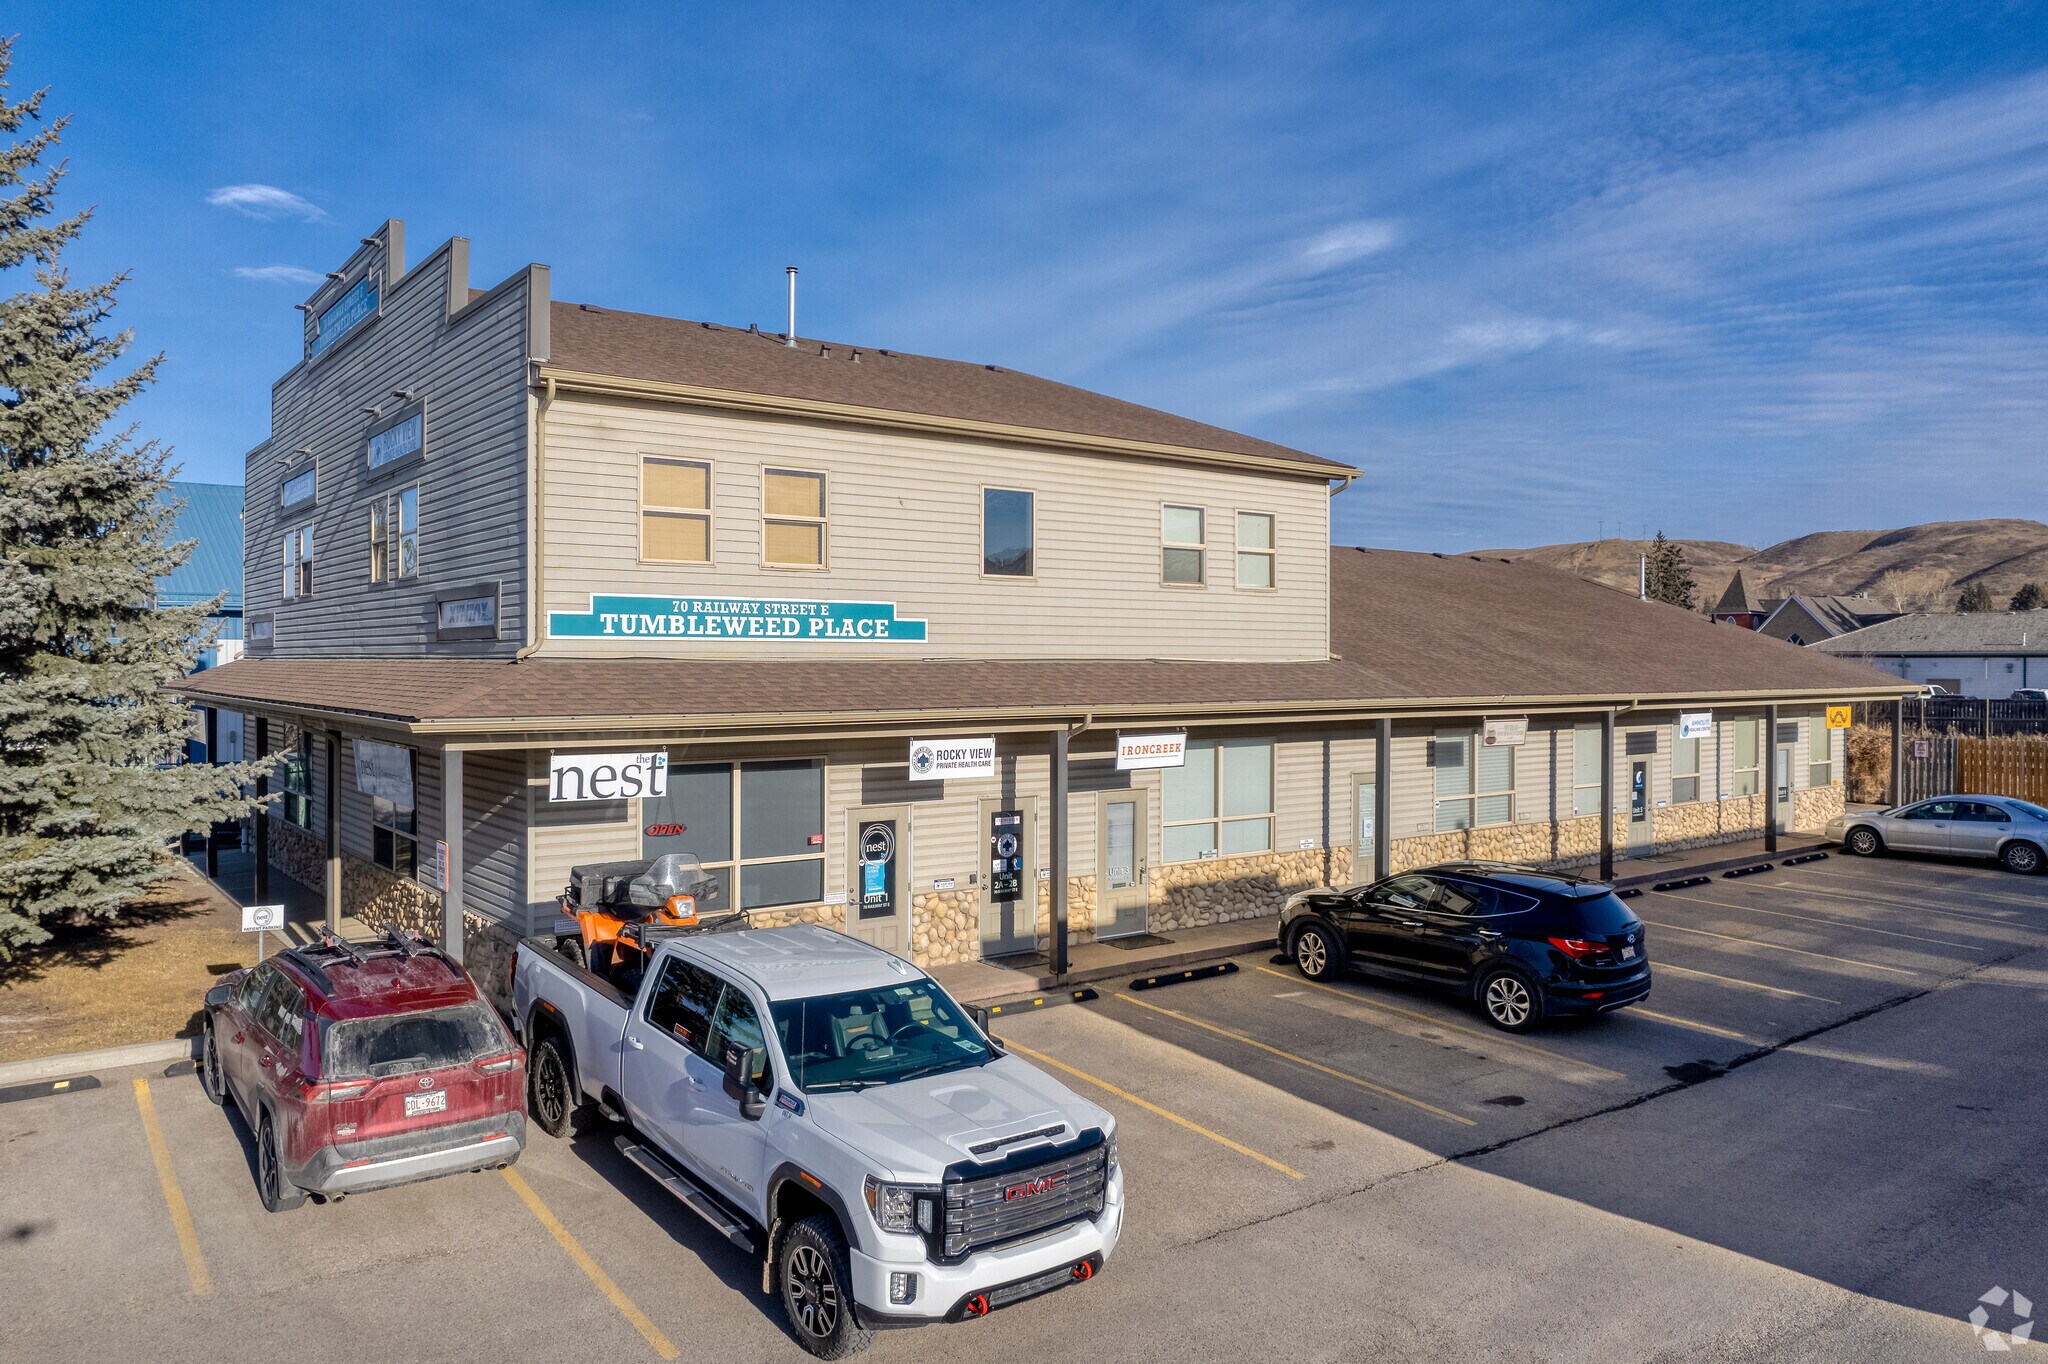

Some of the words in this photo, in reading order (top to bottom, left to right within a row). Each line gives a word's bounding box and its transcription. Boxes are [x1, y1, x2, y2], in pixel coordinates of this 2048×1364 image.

[319, 313, 351, 348] TUMBLEWEED
[350, 298, 368, 323] PLACE
[401, 417, 417, 442] VIEW
[672, 601, 688, 613] 70
[692, 602, 761, 614] RAILWAY
[764, 603, 818, 615] STREET
[820, 605, 829, 616] E
[599, 613, 801, 637] TUMBLEWEED
[808, 618, 889, 638] PLACE
[936, 748, 967, 761] ROCKY
[969, 747, 992, 759] VIEW
[1121, 743, 1182, 756] IRONCREEK
[636, 753, 650, 764] the
[936, 761, 957, 770] PRIVATE
[958, 760, 978, 769] HEALTH
[978, 760, 992, 768] CARE
[360, 758, 376, 778] nest
[551, 753, 665, 801] nest
[647, 823, 686, 836] OPEN
[865, 841, 886, 853] nest
[999, 872, 1013, 881] Unit
[994, 881, 1004, 889] 2A
[1008, 879, 1018, 888] 2B
[863, 894, 882, 904] Unit
[1005, 1172, 1067, 1202] GMC
